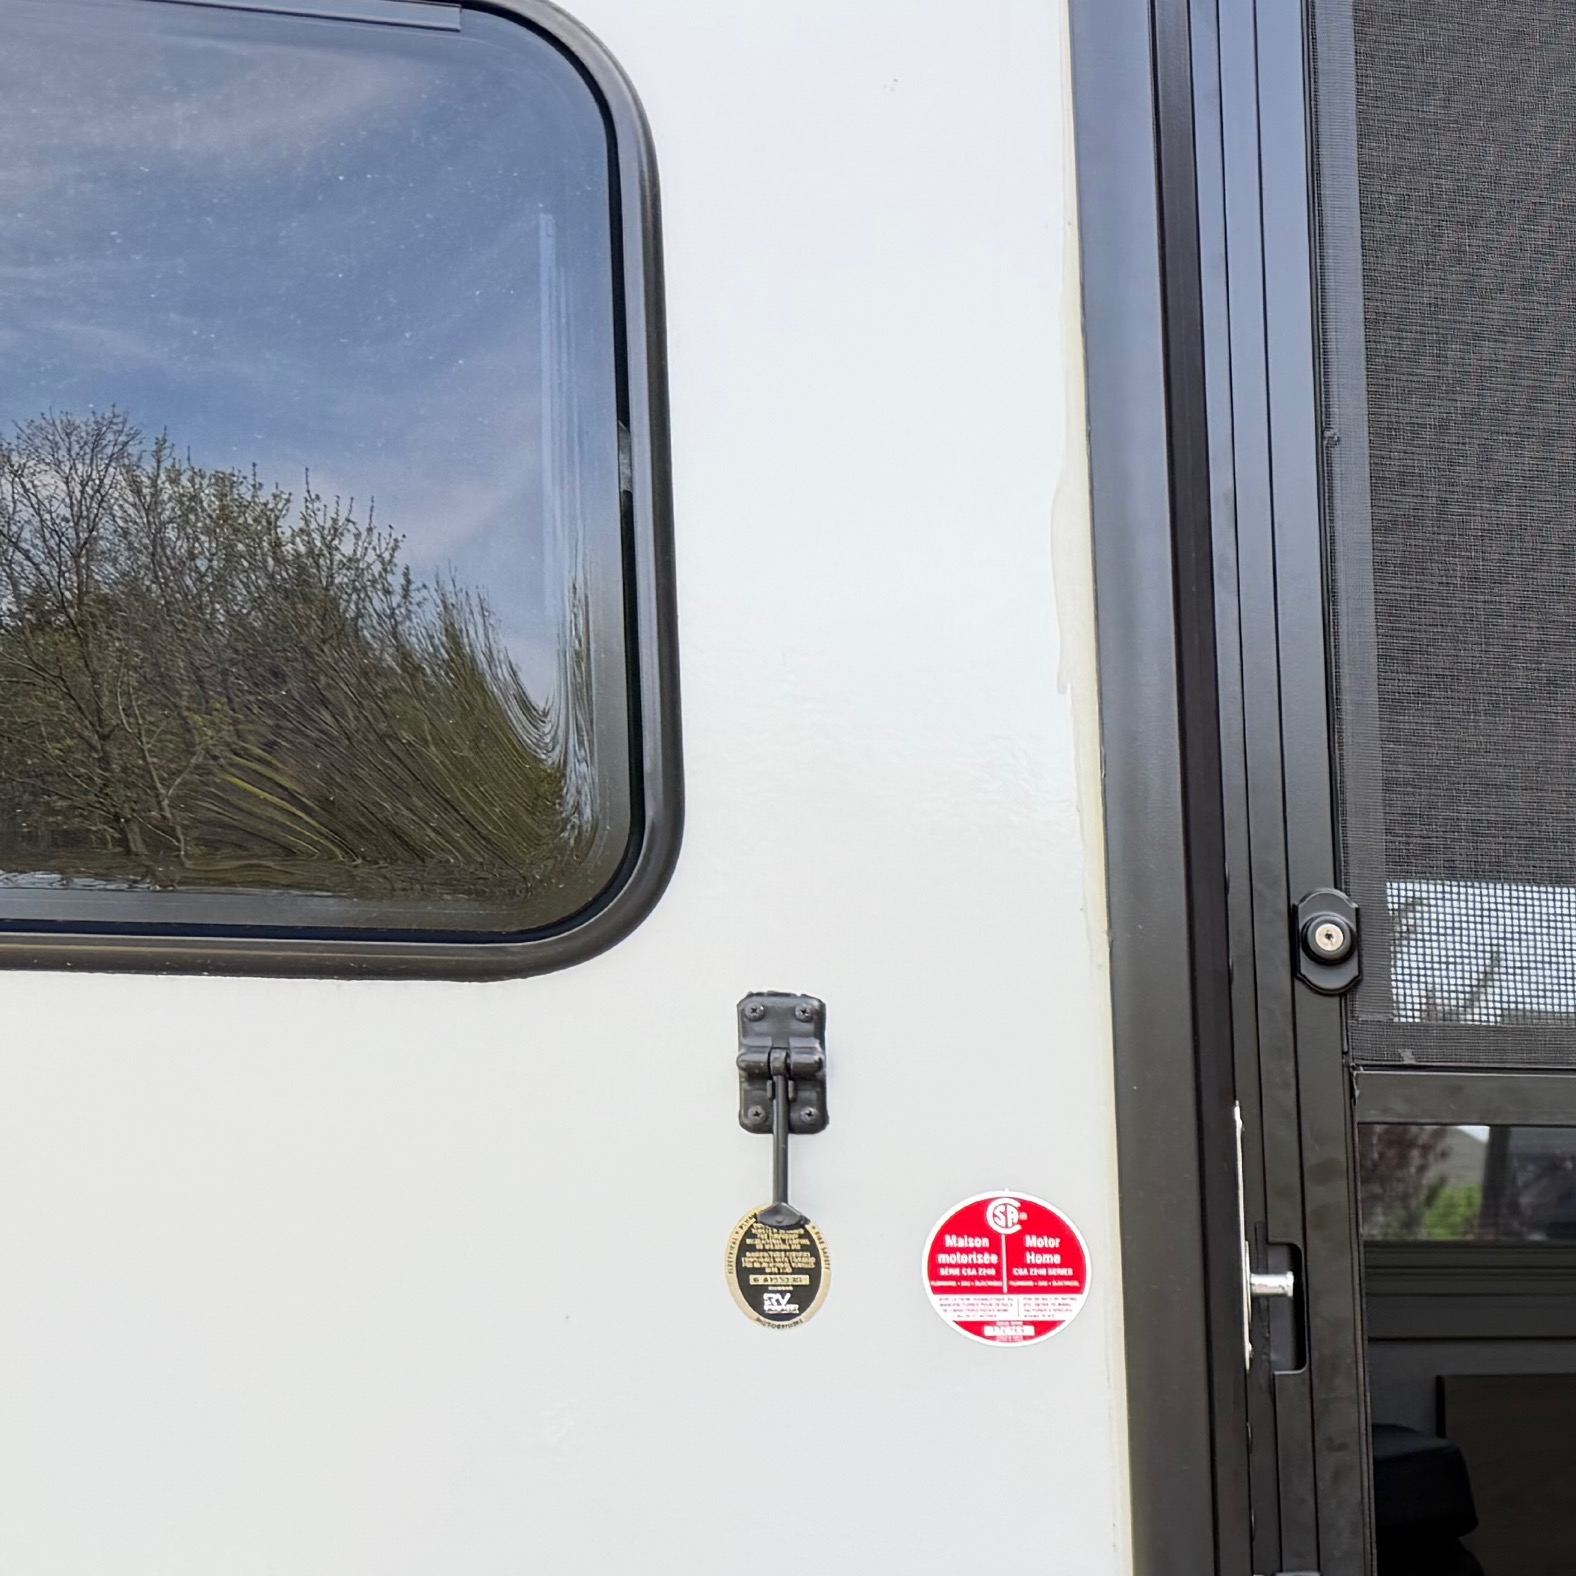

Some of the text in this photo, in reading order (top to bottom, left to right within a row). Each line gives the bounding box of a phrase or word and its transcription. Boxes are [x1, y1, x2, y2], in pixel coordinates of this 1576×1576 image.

[986, 1197, 1022, 1235] CSA
[945, 1234, 990, 1248] Maison
[1025, 1234, 1061, 1248] Motor
[1026, 1251, 1061, 1265] Home
